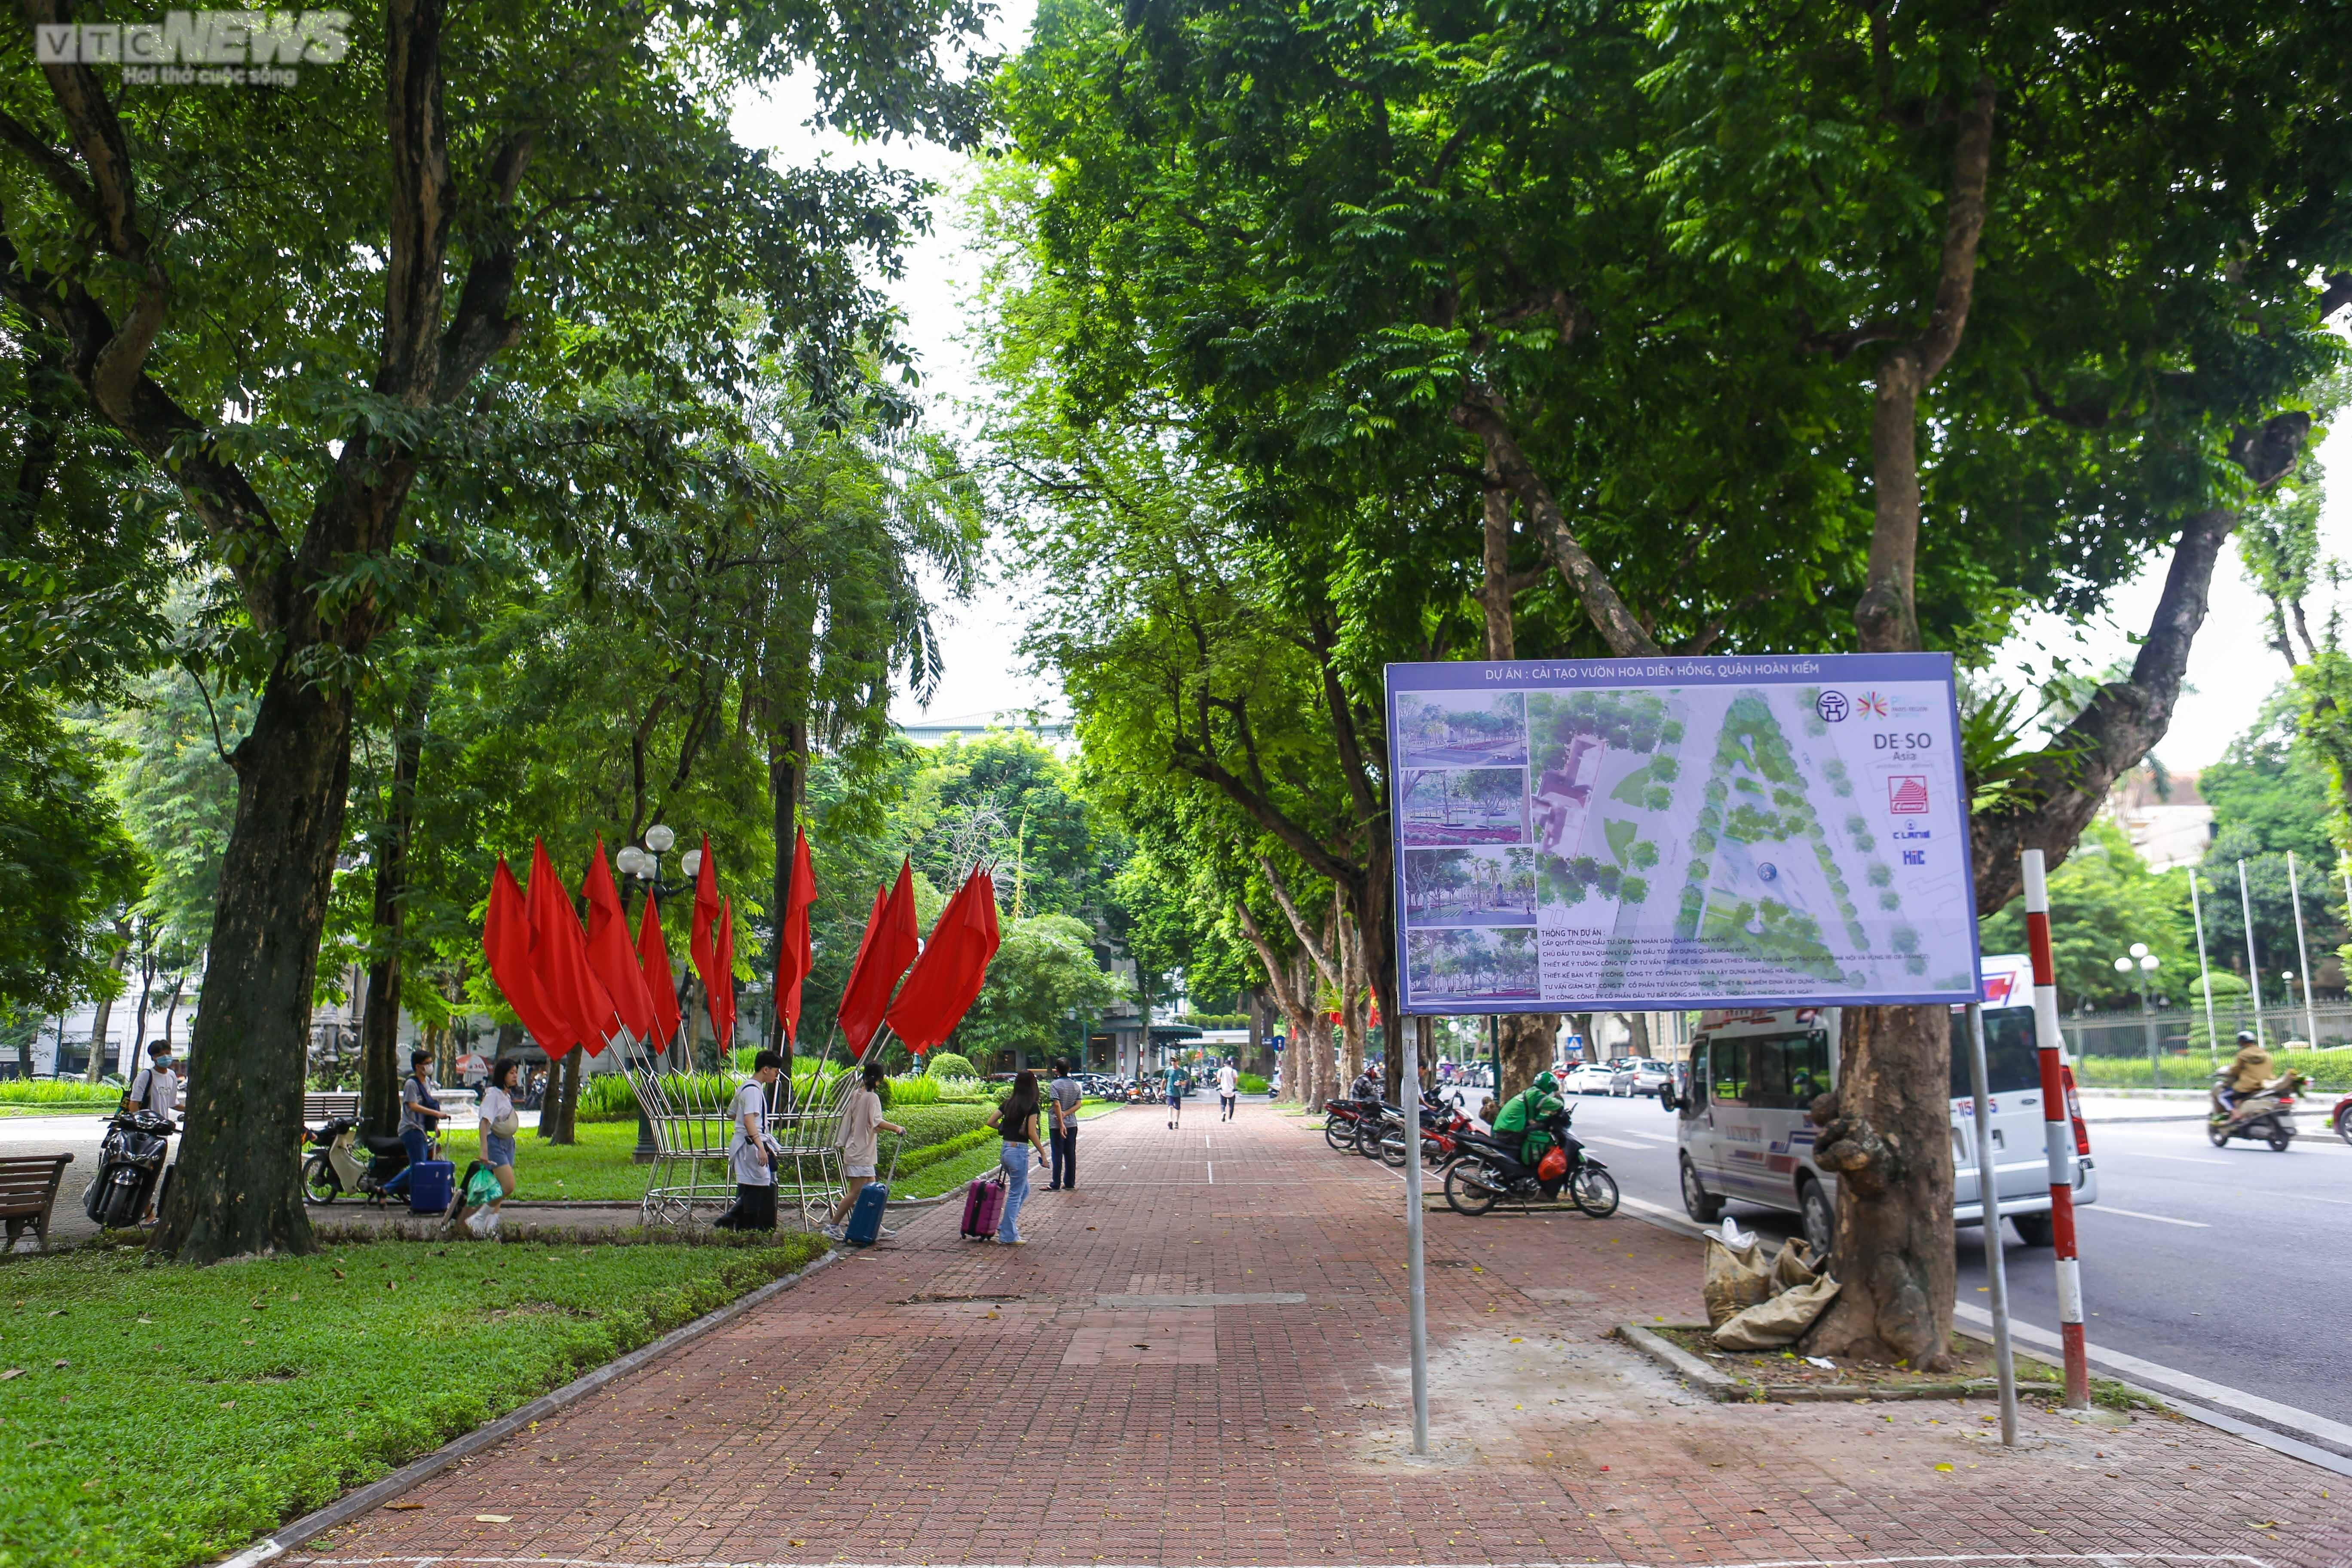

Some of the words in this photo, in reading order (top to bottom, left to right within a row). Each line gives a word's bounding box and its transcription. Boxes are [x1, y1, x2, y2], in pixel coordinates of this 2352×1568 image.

[1485, 668, 1503, 681] DỰ
[1506, 667, 1522, 680] ÁN
[1532, 665, 1550, 679] CẢI
[1553, 668, 1577, 680] TẠO
[1580, 665, 1615, 678] VƯỜN
[1618, 667, 1644, 677] HOA
[1647, 664, 1673, 676] DIÊN
[1717, 663, 1752, 677] QUẬN
[1755, 662, 1788, 674] HOÀN
[1792, 660, 1819, 673] KIẾM
[1893, 751, 1916, 761] Asia
[1541, 929, 1565, 937] THÔNG
[1580, 929, 1590, 937] DỰ
[1592, 927, 1602, 936] ÁN
[1555, 939, 1574, 947] QUYẾT
